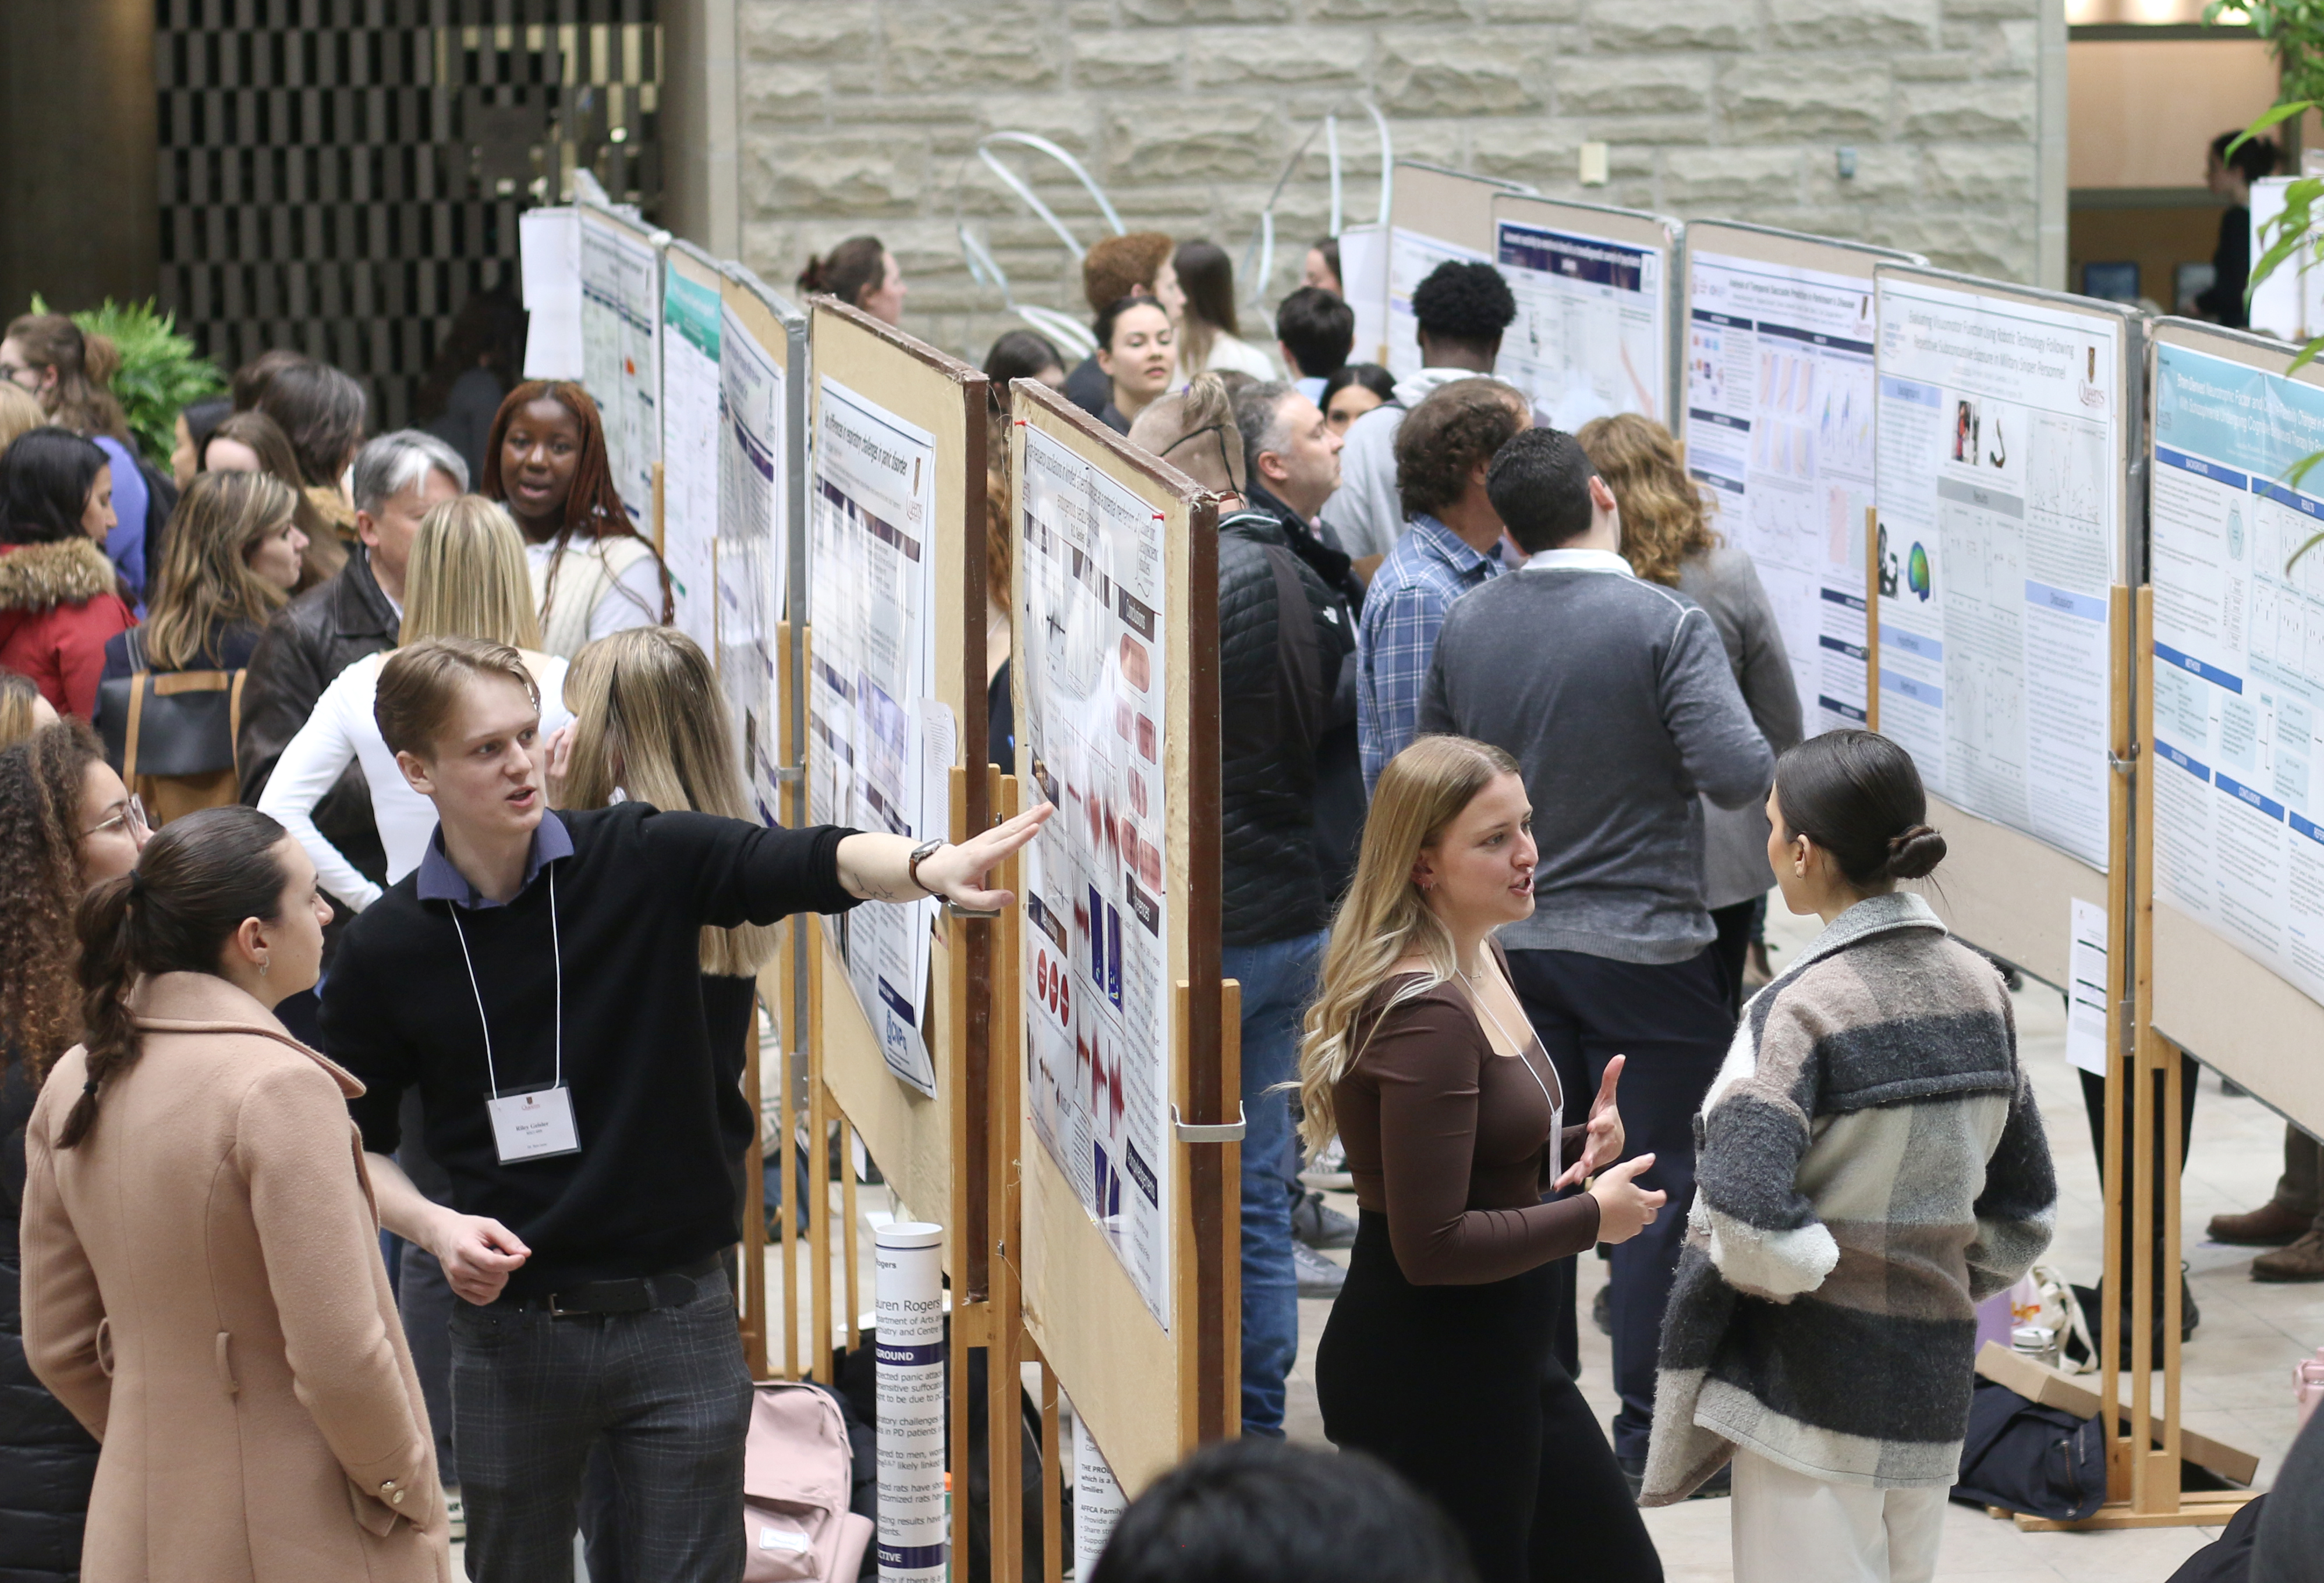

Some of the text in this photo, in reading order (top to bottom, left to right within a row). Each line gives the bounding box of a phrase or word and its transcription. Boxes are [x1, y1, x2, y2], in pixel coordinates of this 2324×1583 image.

[2017, 331, 2045, 353] Technology
[2046, 337, 2074, 360] Following
[2019, 357, 2036, 374] Sniper
[2038, 360, 2066, 379] Personnel
[891, 450, 907, 476] disorder
[1126, 598, 1146, 630] Conclusions
[904, 1300, 940, 1313] Rogers
[917, 1326, 938, 1335] Centre
[901, 1373, 923, 1382] panic
[897, 1395, 906, 1403] be
[899, 1415, 938, 1426] challenges
[893, 1428, 904, 1437] PD
[907, 1427, 937, 1438] patients
[898, 1462, 917, 1471] likely
[920, 1460, 940, 1469] linked
[1081, 1464, 1091, 1472] THE
[1081, 1484, 1103, 1493] families
[1100, 1507, 1122, 1516] Family
[898, 1517, 924, 1525] results
[1084, 1515, 1107, 1524] Provide
[1083, 1525, 1100, 1534] Share
